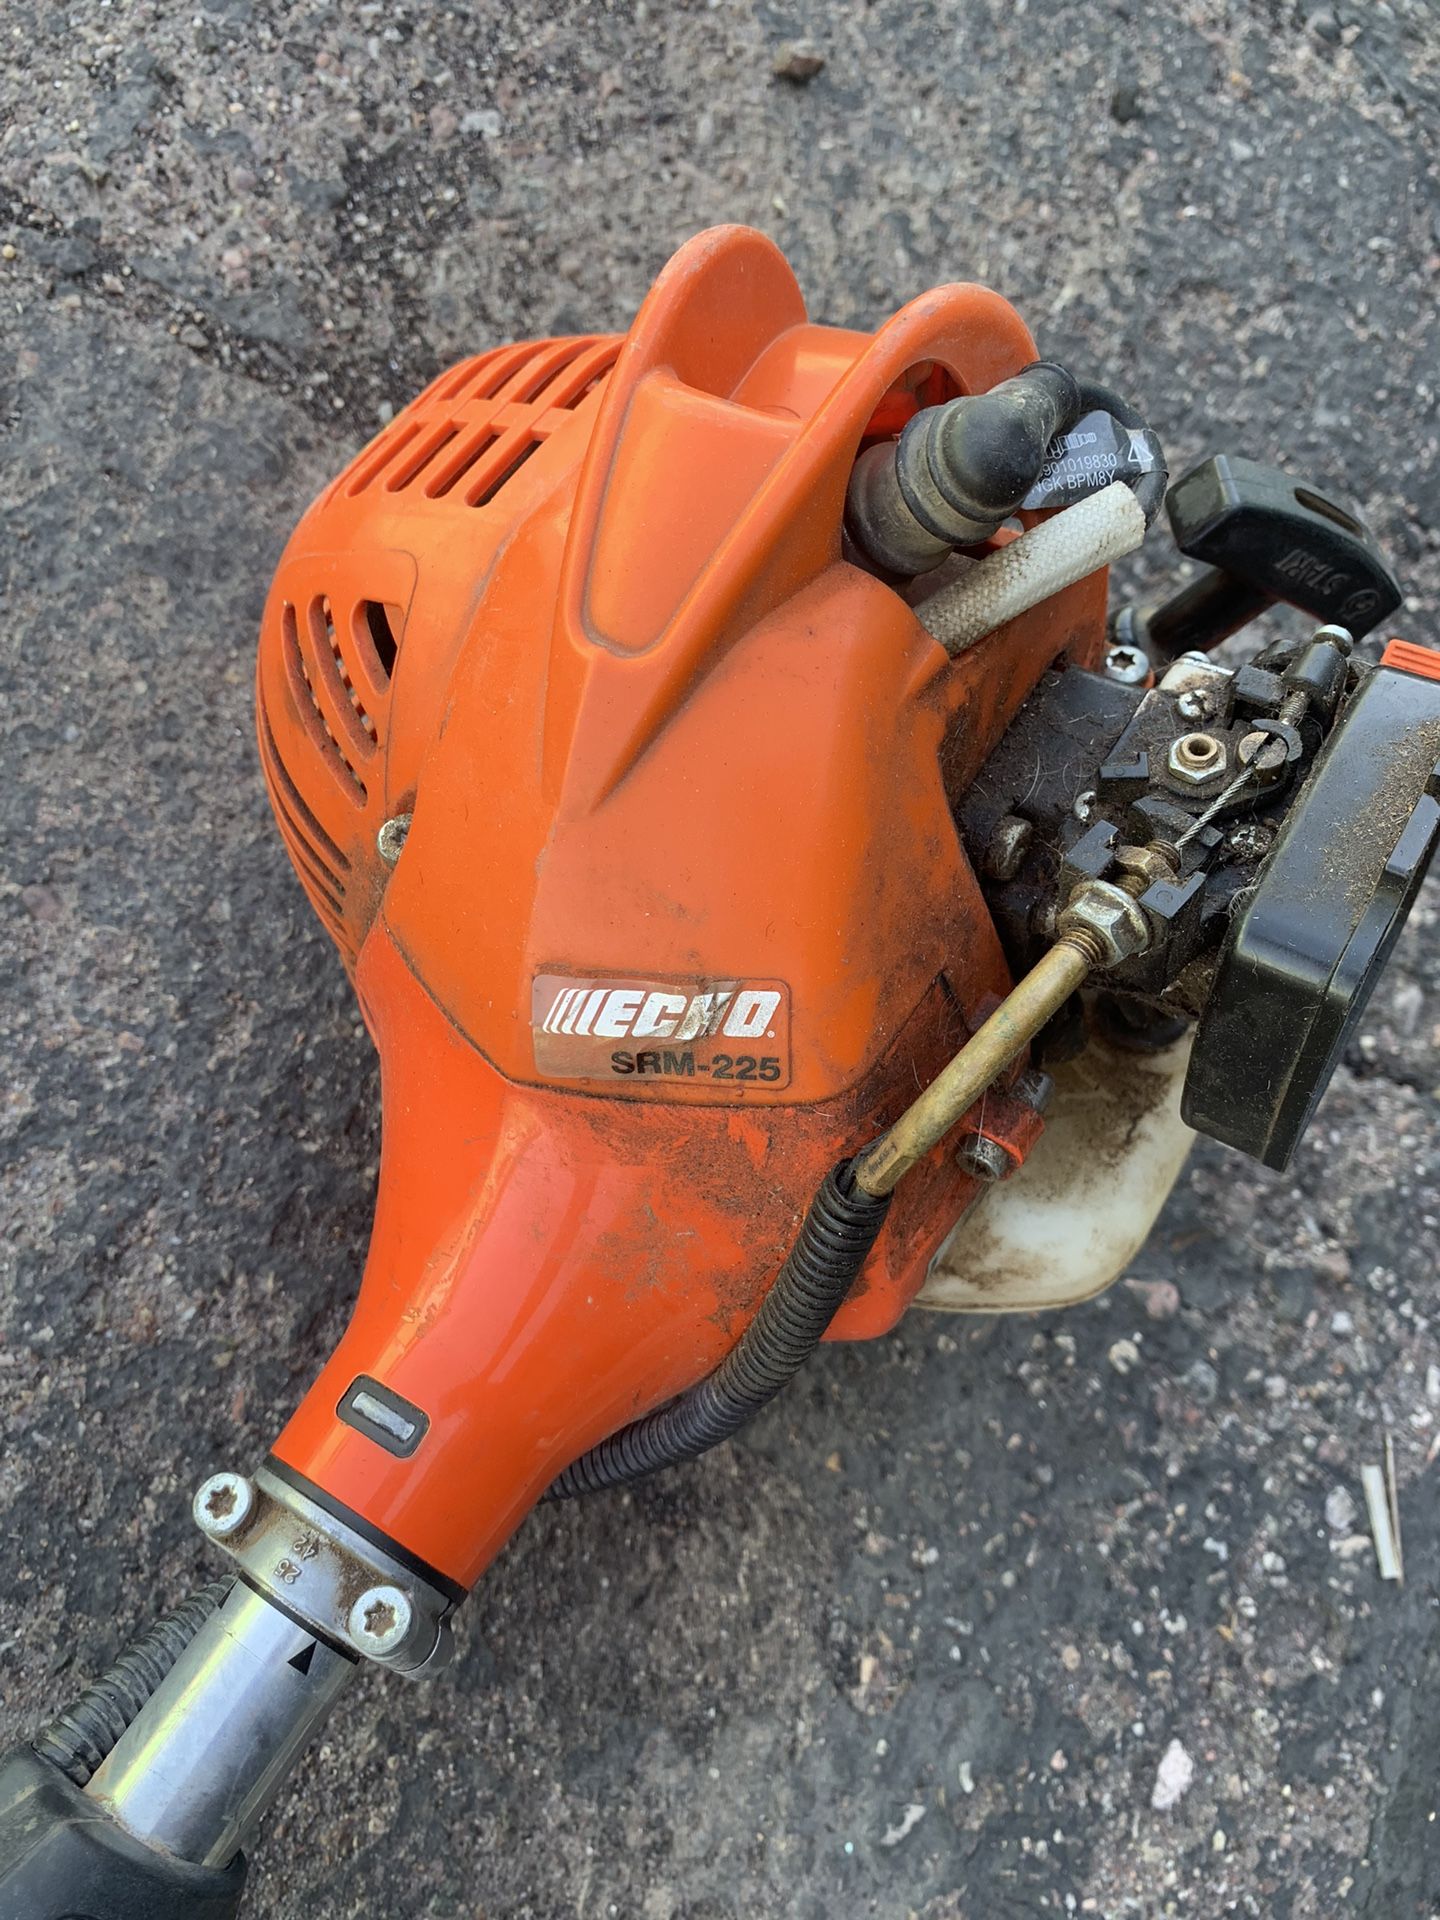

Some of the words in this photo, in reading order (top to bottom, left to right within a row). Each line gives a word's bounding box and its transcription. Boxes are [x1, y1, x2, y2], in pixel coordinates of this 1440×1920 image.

[1041, 452, 1118, 477] 901019830
[1067, 469, 1116, 490] BPM8Y
[593, 988, 782, 1041] ECHO
[610, 1050, 782, 1082] SRM-225
[273, 1559, 302, 1584] 25
